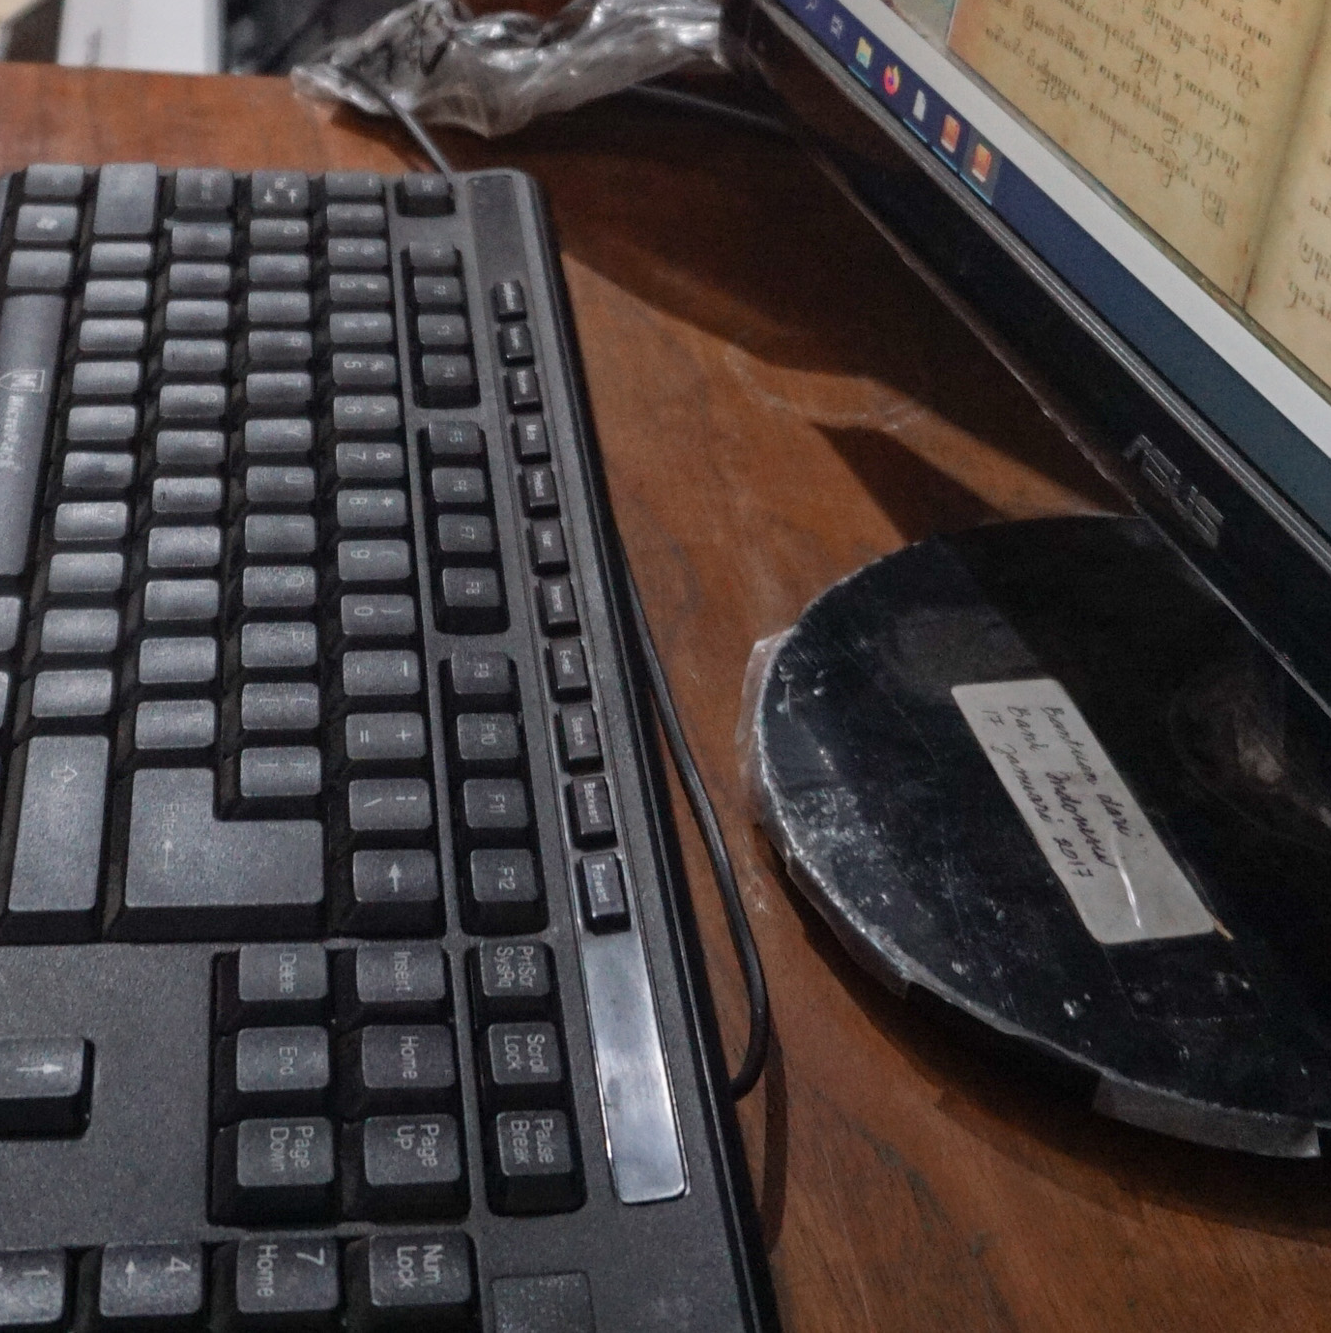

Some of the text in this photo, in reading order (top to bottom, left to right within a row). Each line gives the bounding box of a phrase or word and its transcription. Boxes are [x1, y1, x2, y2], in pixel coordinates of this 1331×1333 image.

[349, 497, 368, 505] 8
[350, 549, 371, 559] 9
[473, 663, 489, 679] F9
[1041, 705, 1098, 785] Bantuan
[489, 793, 507, 815] F11
[980, 709, 1004, 728] 17
[1053, 834, 1094, 879] 2017
[497, 866, 516, 891] F12
[591, 863, 610, 903] Forward
[279, 953, 298, 994] Delete
[394, 951, 413, 992] Insert
[494, 946, 515, 988] SysRq
[518, 945, 537, 988] PrtScr
[278, 1045, 298, 1076] End
[399, 1035, 419, 1079] Home
[503, 1034, 524, 1070] Lock
[526, 1033, 548, 1074] Scroll
[269, 1127, 289, 1172] Down
[289, 1125, 314, 1169] Page
[395, 1125, 416, 1150] Up
[415, 1123, 440, 1167] Page
[509, 1119, 530, 1165] Break
[534, 1118, 555, 1164] Pause
[163, 1256, 191, 1273] 4
[256, 1243, 279, 1297] Home
[296, 1247, 325, 1266] 7
[396, 1245, 418, 1288] Lock
[422, 1244, 444, 1285] Num
